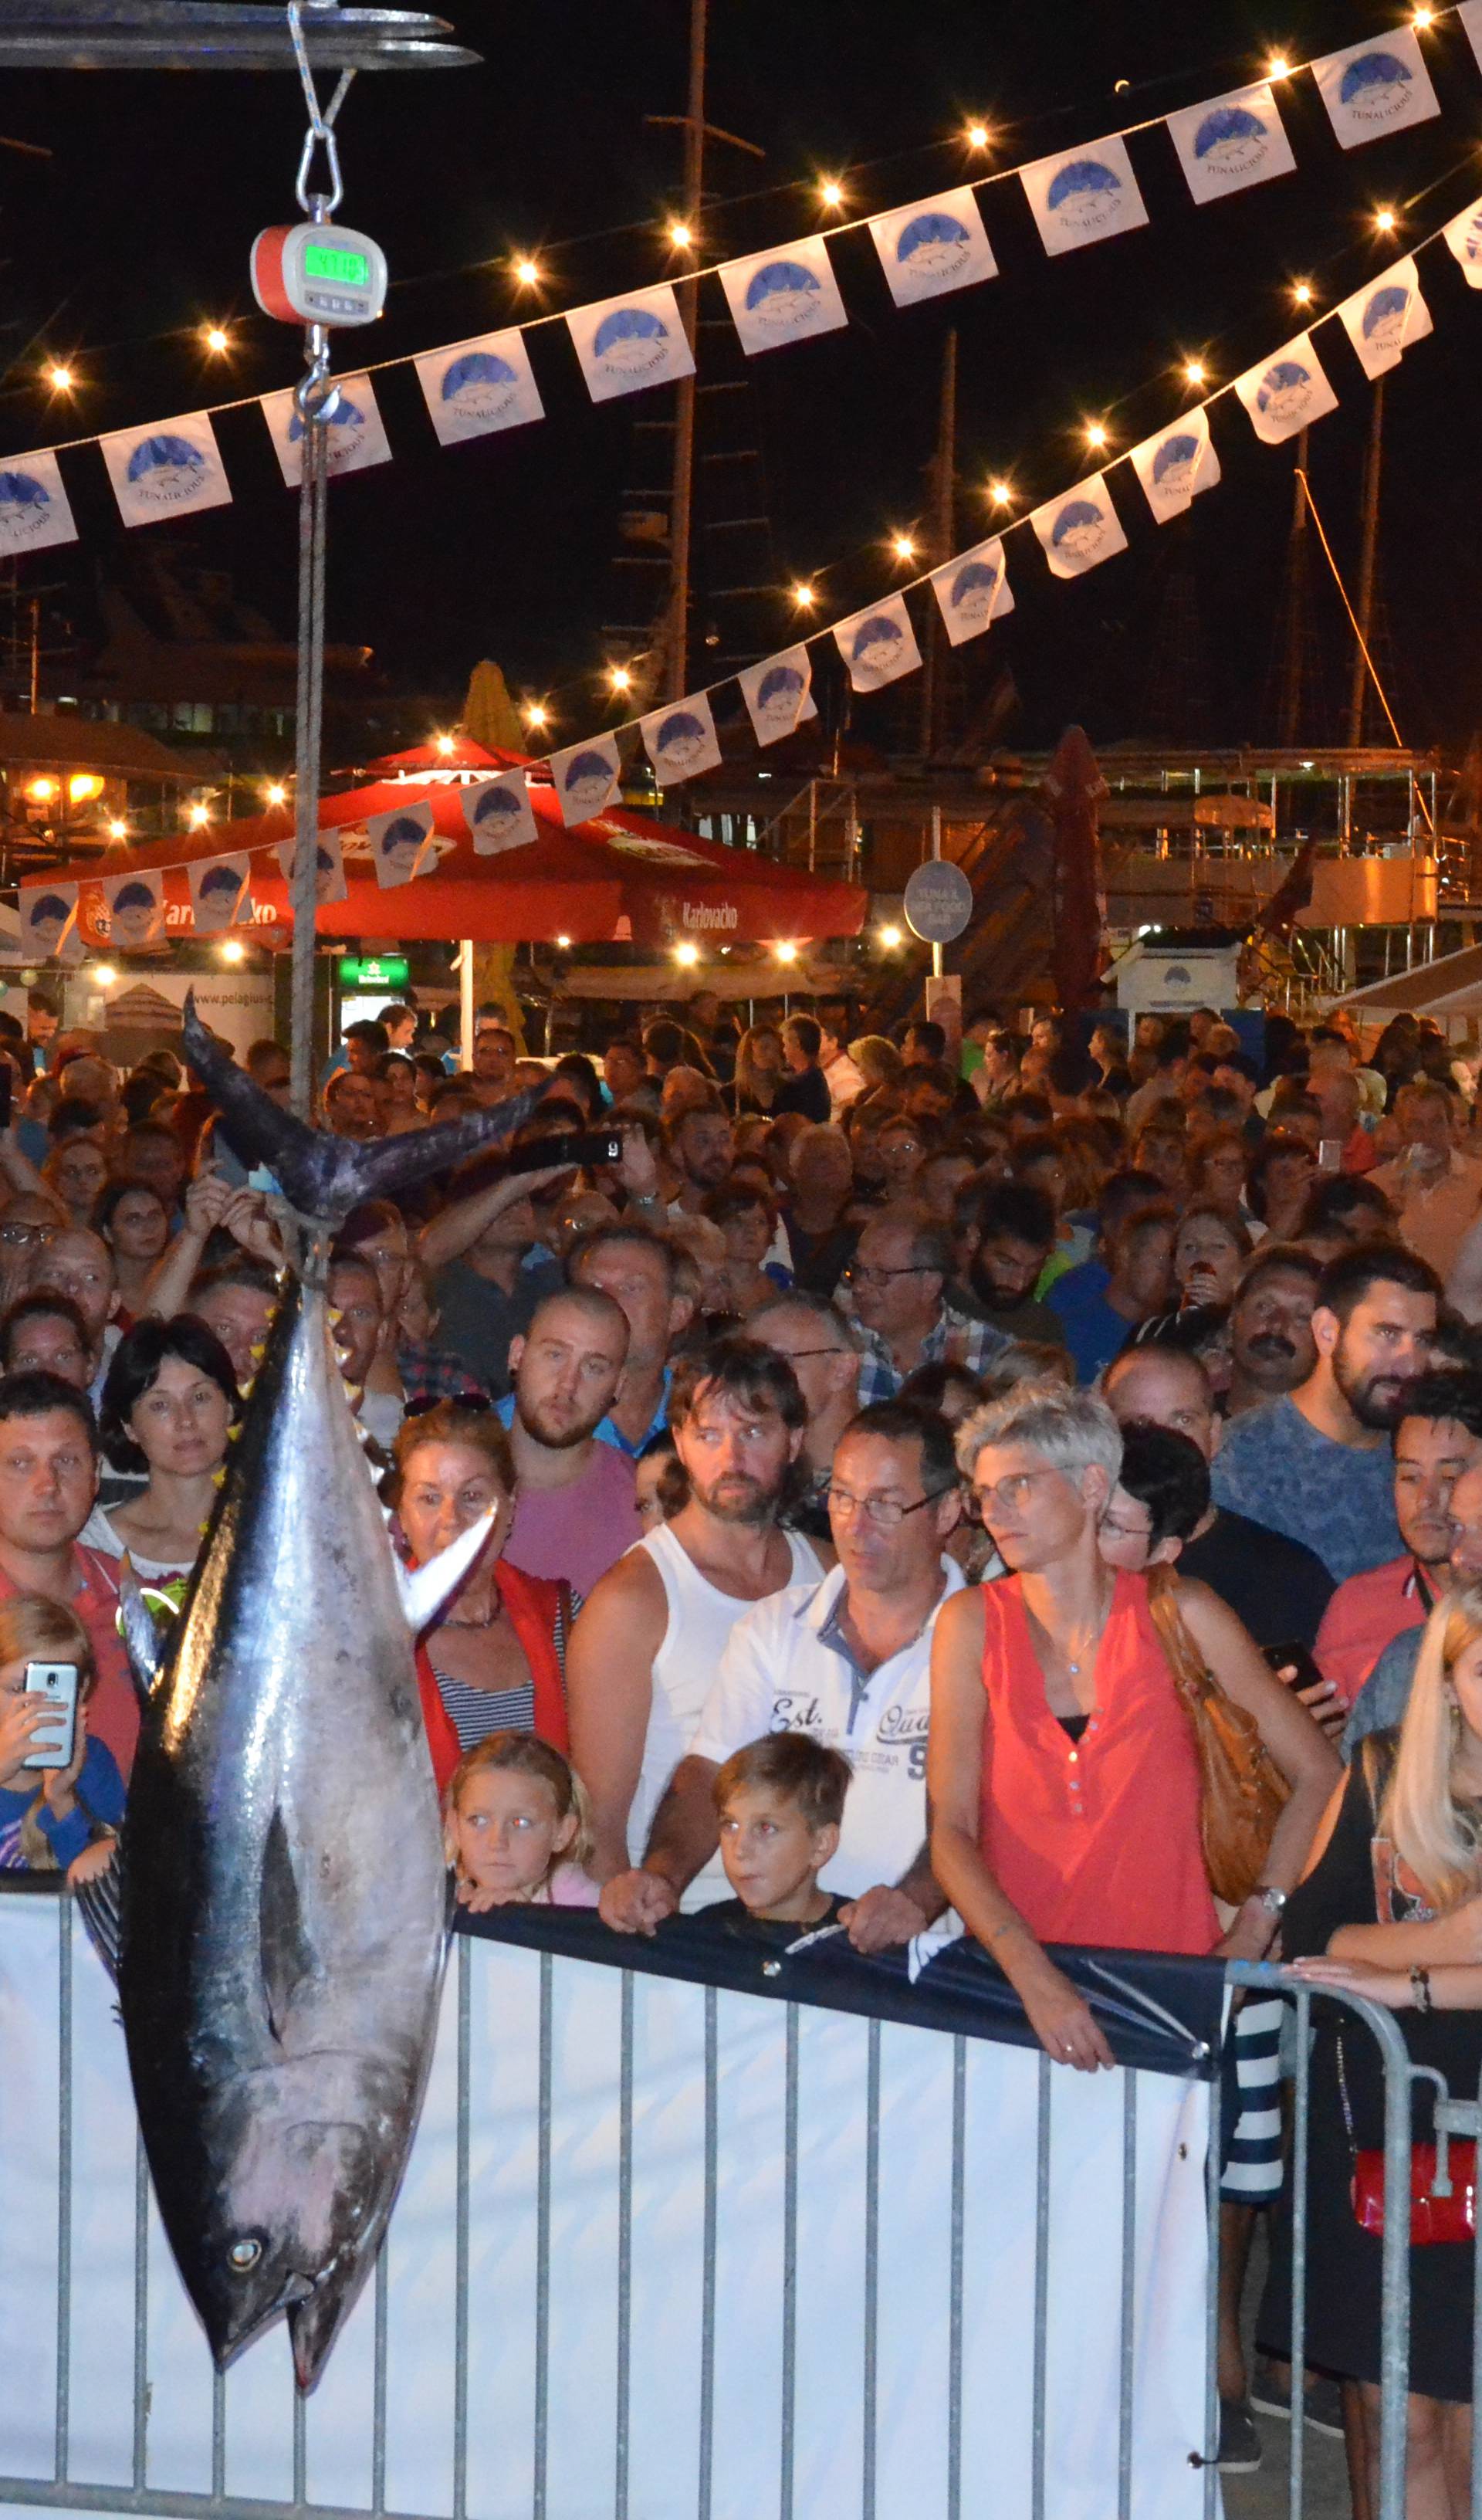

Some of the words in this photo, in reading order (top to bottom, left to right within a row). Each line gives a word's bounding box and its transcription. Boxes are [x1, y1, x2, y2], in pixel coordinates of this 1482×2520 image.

[1351, 89, 1413, 120] TUNALICIOUS
[1206, 145, 1268, 175] TUNALICIOUS
[878, 1705, 929, 1738] Qua
